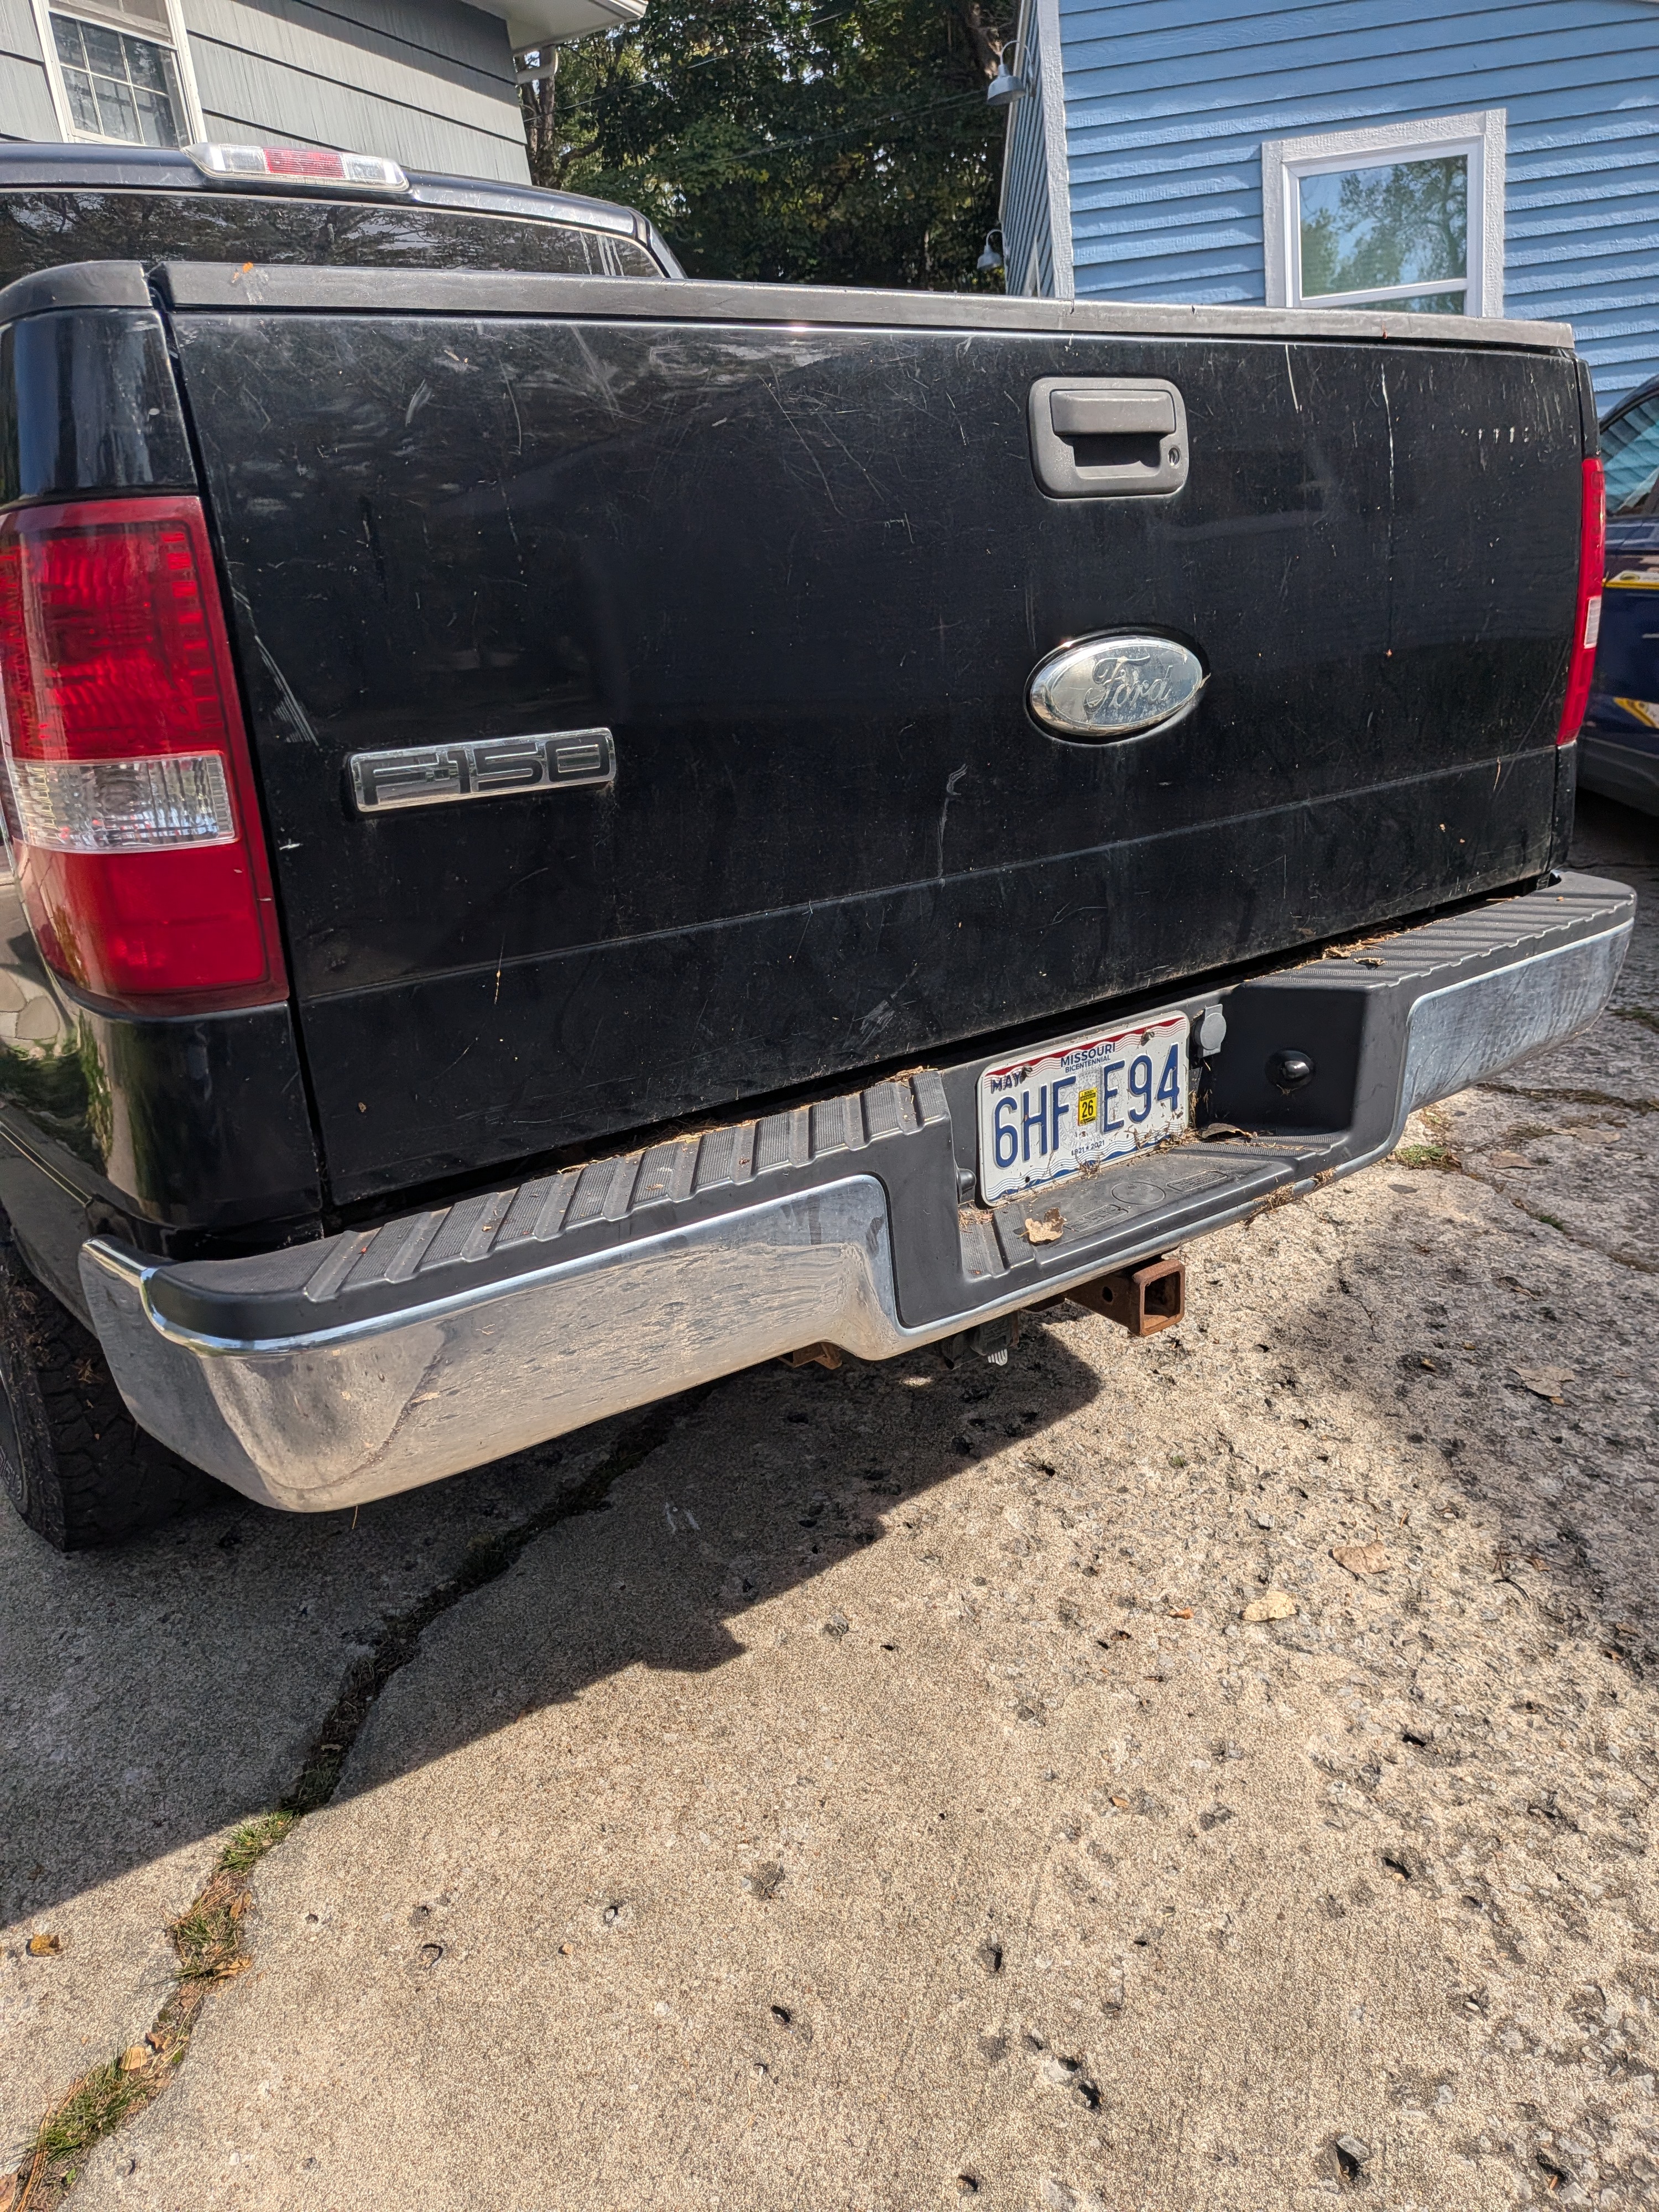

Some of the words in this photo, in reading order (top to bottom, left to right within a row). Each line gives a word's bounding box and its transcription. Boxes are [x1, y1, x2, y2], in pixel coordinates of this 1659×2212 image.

[1083, 654, 1173, 714] Ford
[359, 734, 611, 805] F-150
[1061, 1043, 1115, 1067] MISSOURI
[1065, 1056, 1110, 1073] BICENTENNIAL
[991, 1072, 1021, 1092] MAY
[994, 1076, 1077, 1169] 6HF
[1103, 1044, 1180, 1134] E94
[1082, 1099, 1094, 1118] 26
[1071, 1146, 1084, 1156] 1821
[1091, 1140, 1105, 1150] 2021
